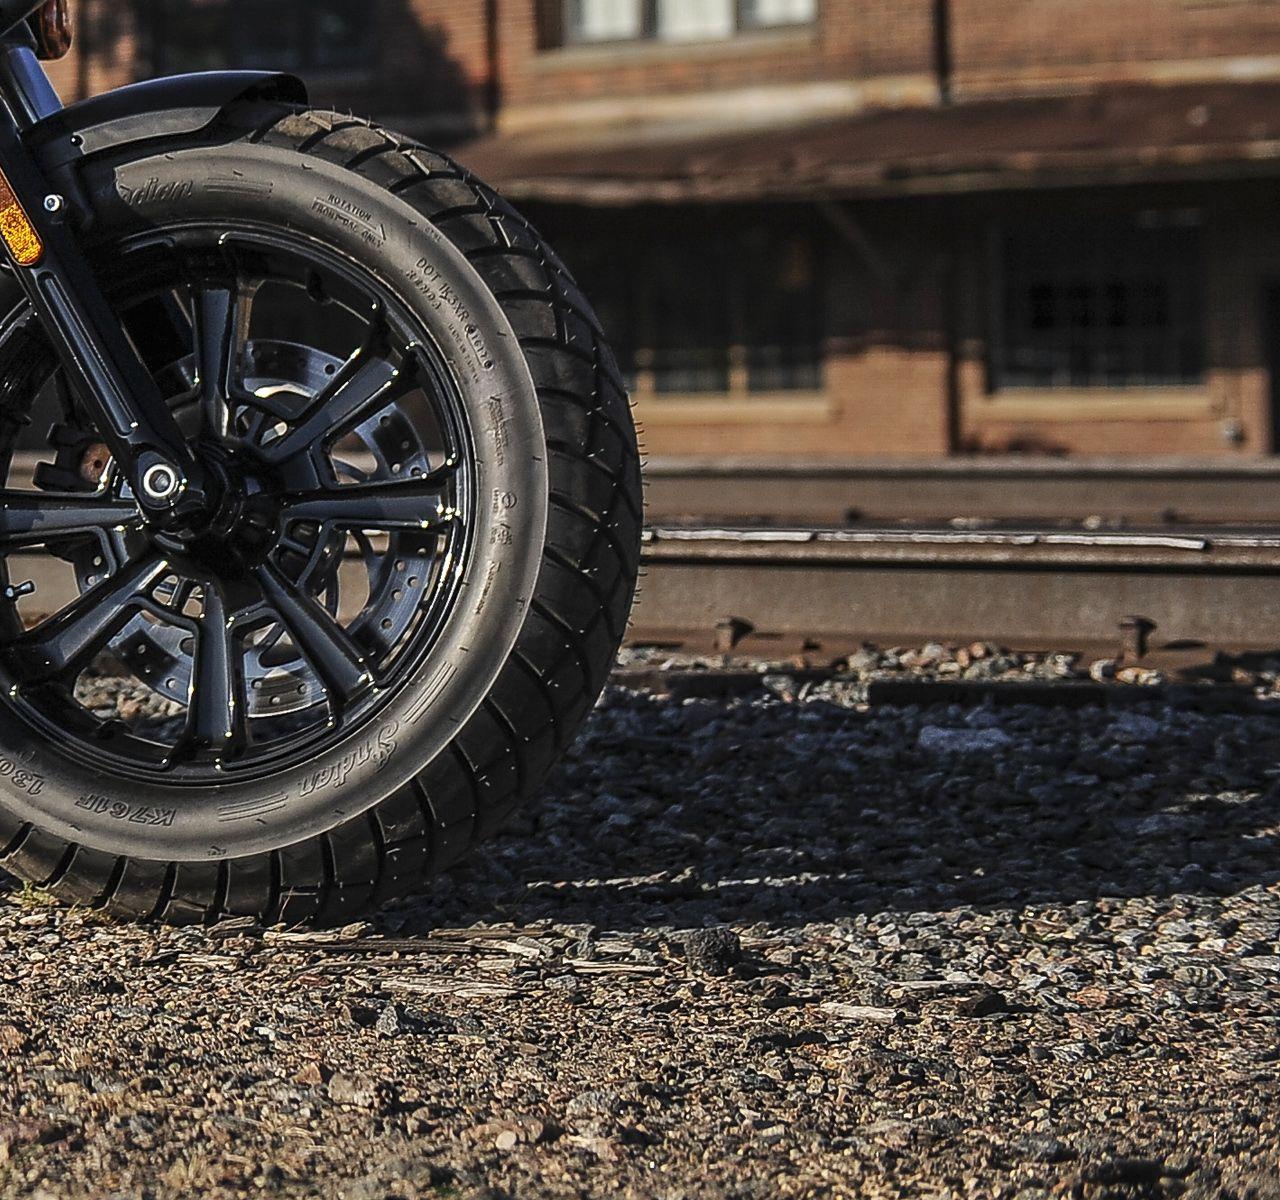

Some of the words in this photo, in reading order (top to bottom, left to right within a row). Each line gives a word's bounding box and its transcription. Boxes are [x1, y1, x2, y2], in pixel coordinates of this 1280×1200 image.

[327, 193, 372, 222] ROTATION
[415, 256, 443, 283] DOT
[296, 720, 400, 797] Indian
[74, 792, 178, 828] K761F
